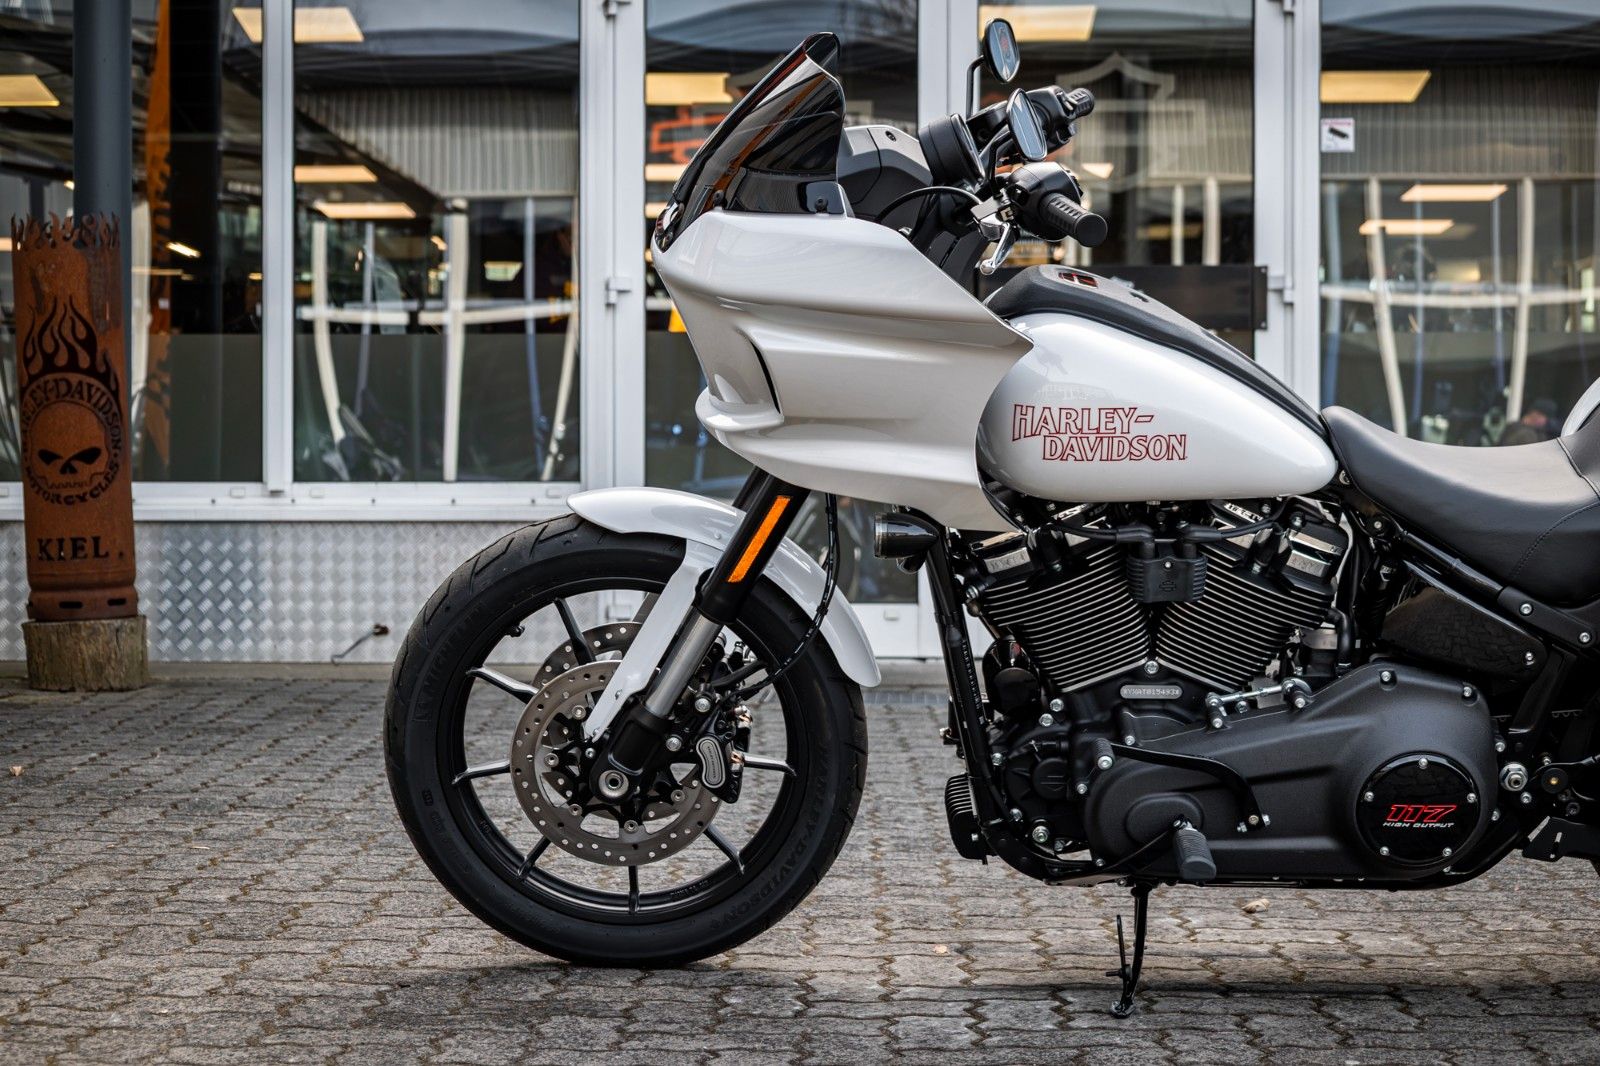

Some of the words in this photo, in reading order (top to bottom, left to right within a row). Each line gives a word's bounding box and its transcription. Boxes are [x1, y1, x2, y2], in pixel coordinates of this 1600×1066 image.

[1012, 404, 1155, 442] HARLEY-
[1042, 434, 1188, 462] DAVIDSON
[25, 462, 121, 506] MOTORCYCLES
[37, 535, 110, 562] KIEL
[1386, 804, 1457, 823] 117
